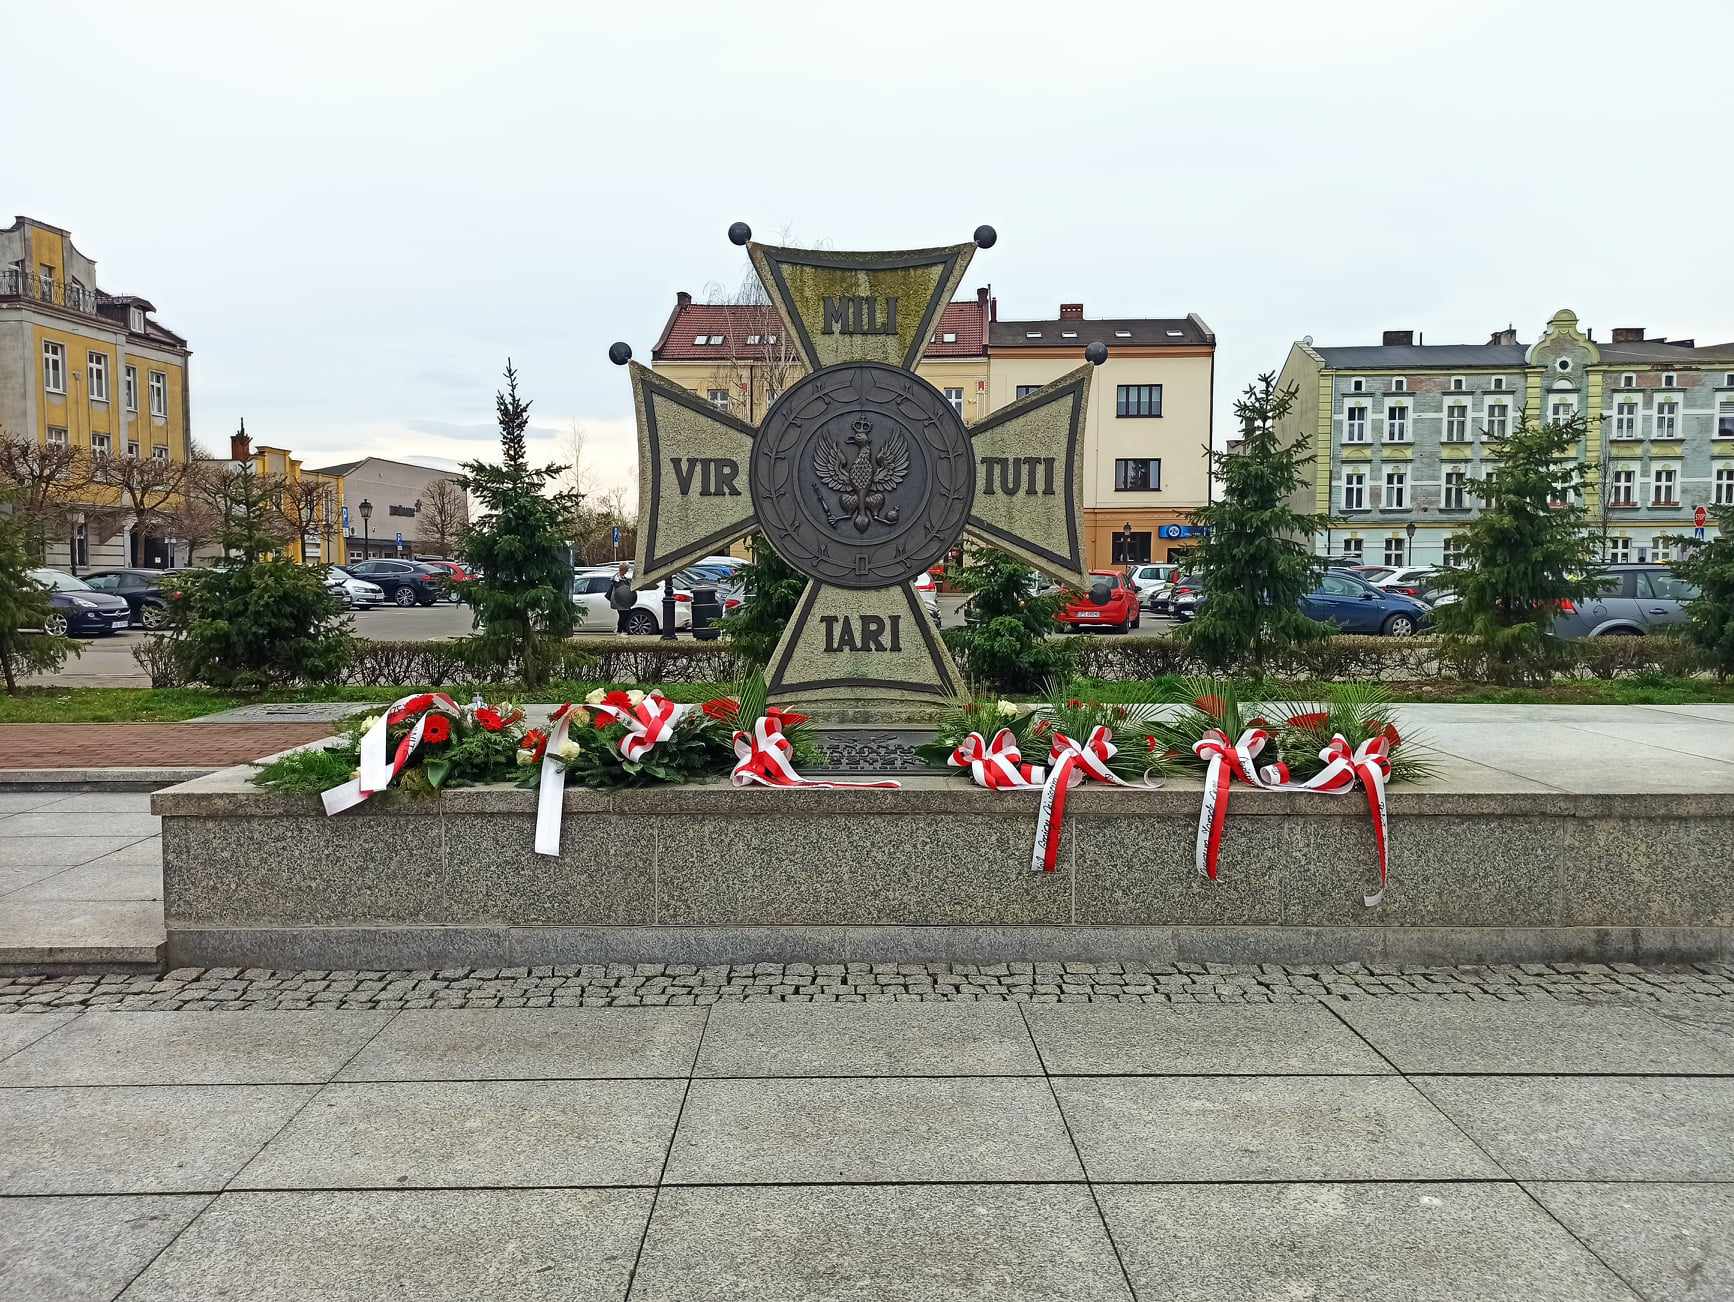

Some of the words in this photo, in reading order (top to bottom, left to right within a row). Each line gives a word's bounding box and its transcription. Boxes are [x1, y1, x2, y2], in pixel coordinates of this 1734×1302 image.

[822, 296, 898, 335] MILI
[670, 458, 741, 496] VIR
[981, 457, 1055, 496] TUTI
[820, 614, 901, 653] TARI
